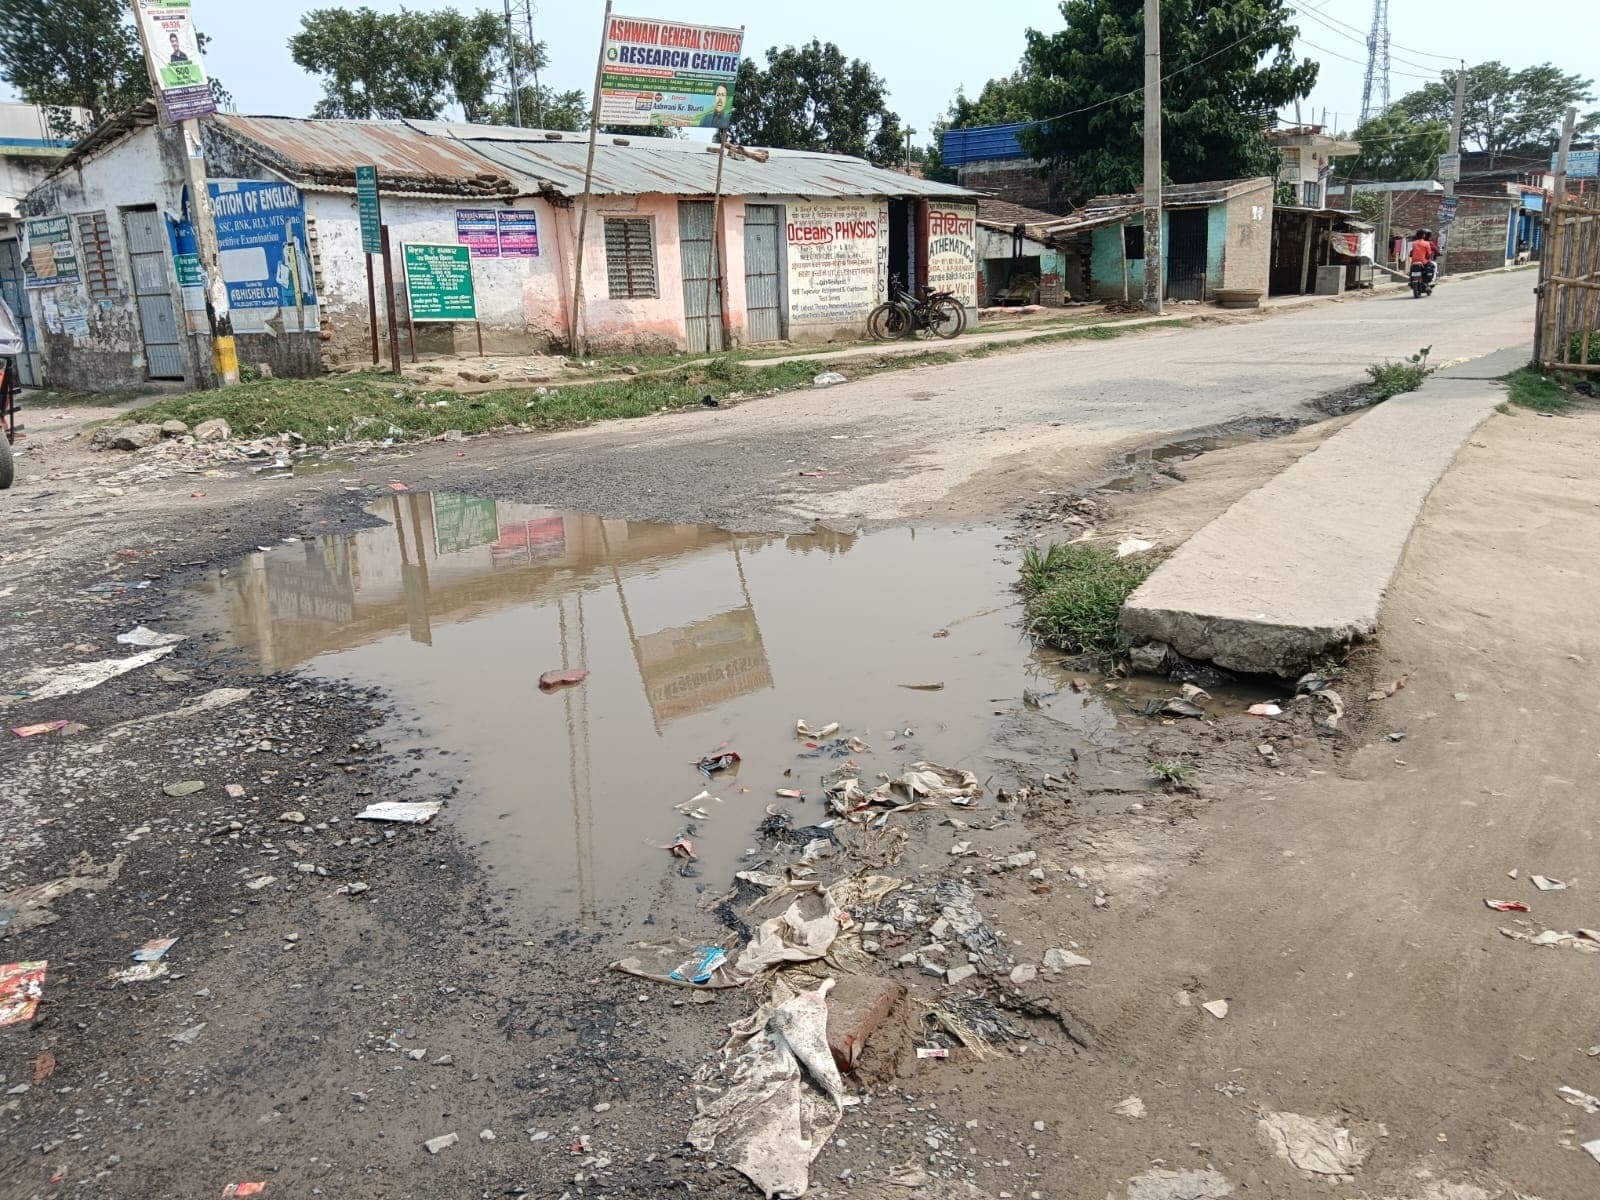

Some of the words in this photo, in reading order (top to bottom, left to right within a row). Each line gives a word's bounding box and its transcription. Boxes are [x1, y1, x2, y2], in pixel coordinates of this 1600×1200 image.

[609, 19, 660, 45] ASHWANI
[660, 24, 703, 50] GENERAL
[703, 30, 742, 53] STUDIES
[608, 50, 617, 59] &
[619, 46, 690, 68] RESEARCH
[691, 53, 738, 72] CENTRE
[244, 193, 257, 213] OF
[259, 185, 299, 210] ENGLISH
[240, 233, 279, 245] Examination
[928, 211, 974, 241] मिथिला
[267, 286, 279, 300] SIR
